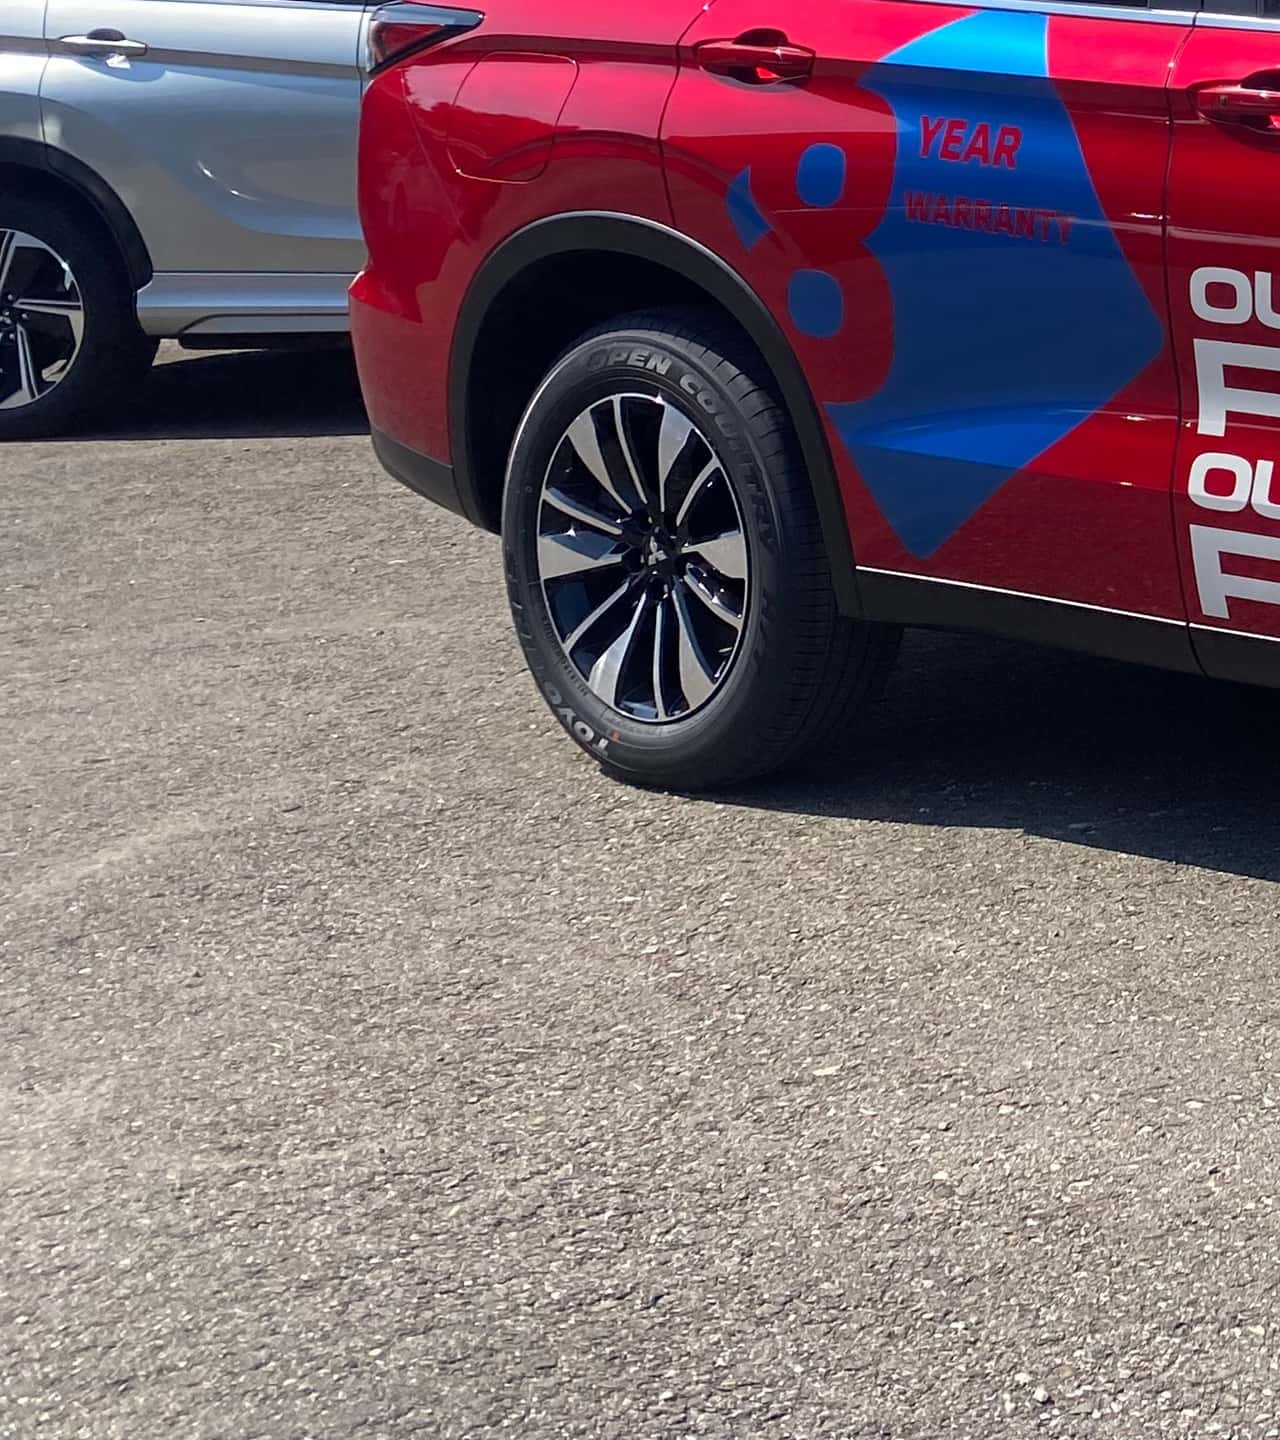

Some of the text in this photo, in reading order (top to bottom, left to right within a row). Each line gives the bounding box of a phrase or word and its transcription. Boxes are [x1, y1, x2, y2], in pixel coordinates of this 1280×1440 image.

[918, 115, 1023, 169] YEAR
[904, 190, 1076, 246] WARRANTY
[586, 348, 673, 376] OPEN
[544, 680, 609, 757] TOYO
